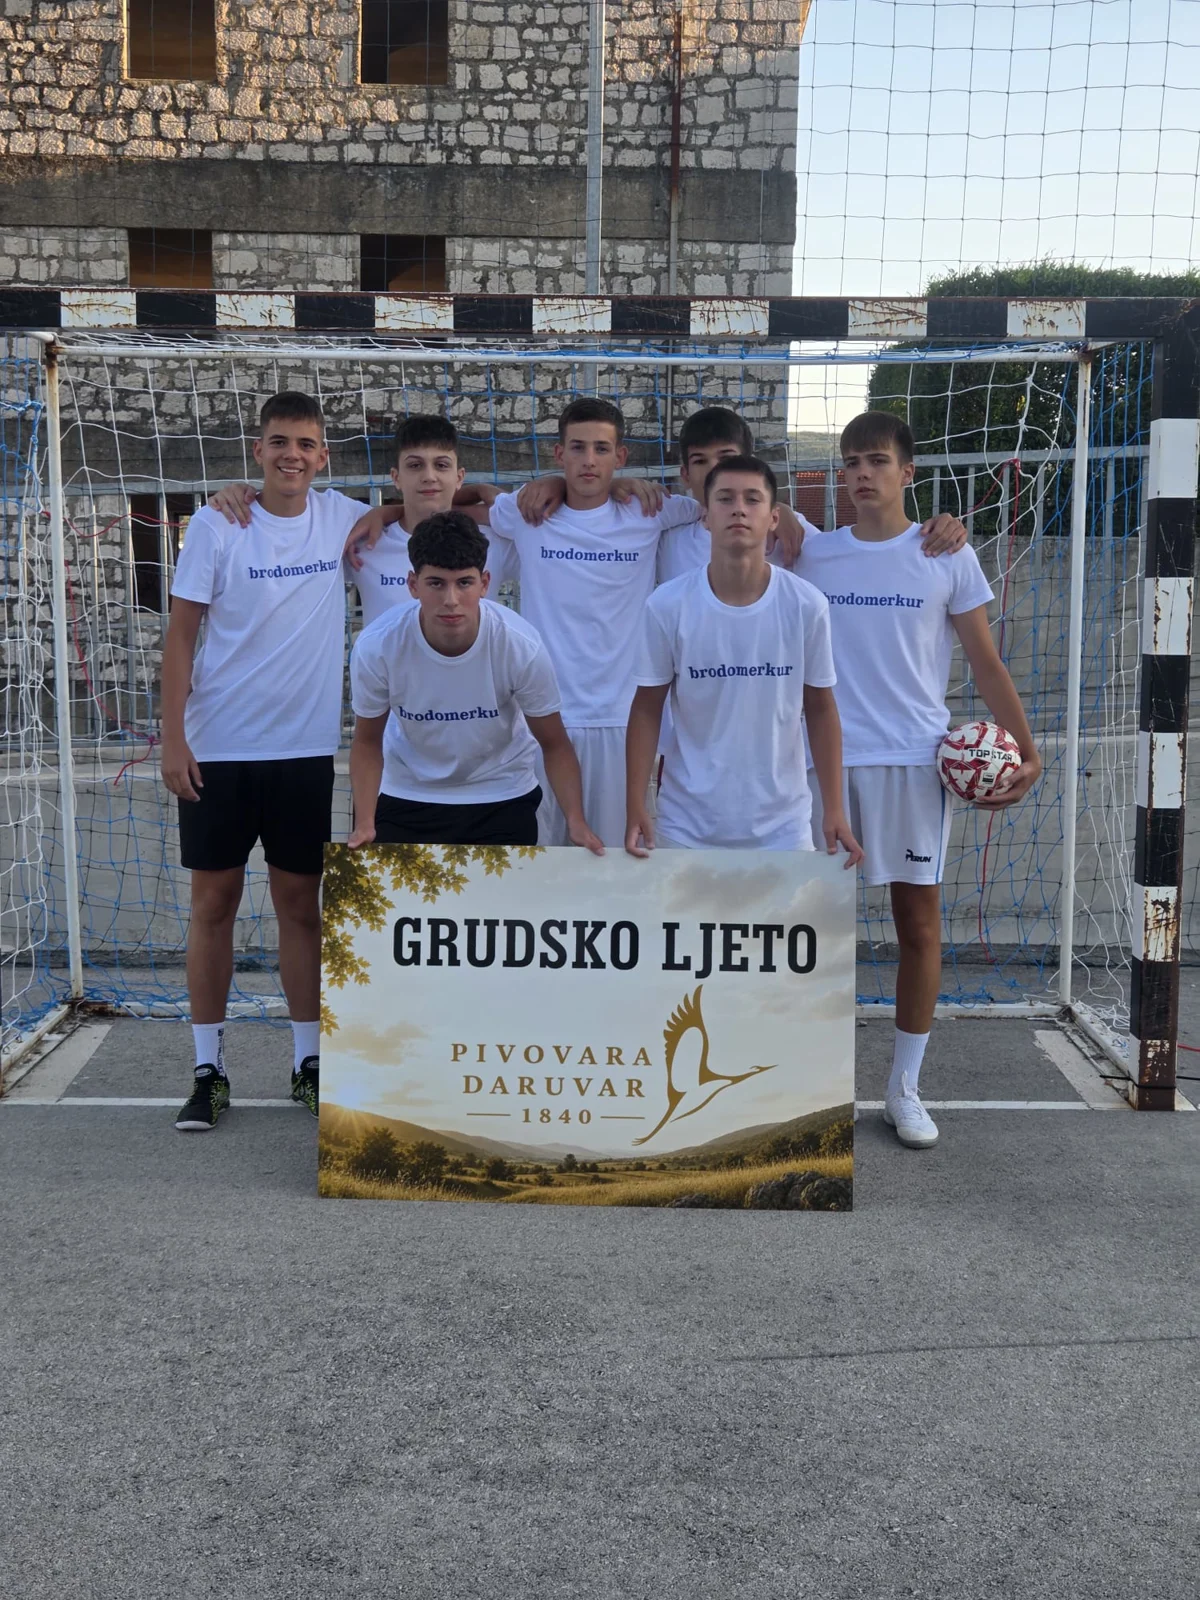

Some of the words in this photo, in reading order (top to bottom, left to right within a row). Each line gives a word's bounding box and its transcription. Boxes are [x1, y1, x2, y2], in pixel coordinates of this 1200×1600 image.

[540, 546, 640, 562] brodomerkur
[688, 662, 793, 679] brodomerkur
[398, 706, 499, 721] brodomerku
[393, 916, 639, 970] GRUDSKO
[662, 922, 817, 979] LJETO
[451, 1043, 652, 1066] PIVOVARA
[462, 1075, 645, 1098] DARUVAR
[522, 1108, 592, 1124] 1840
